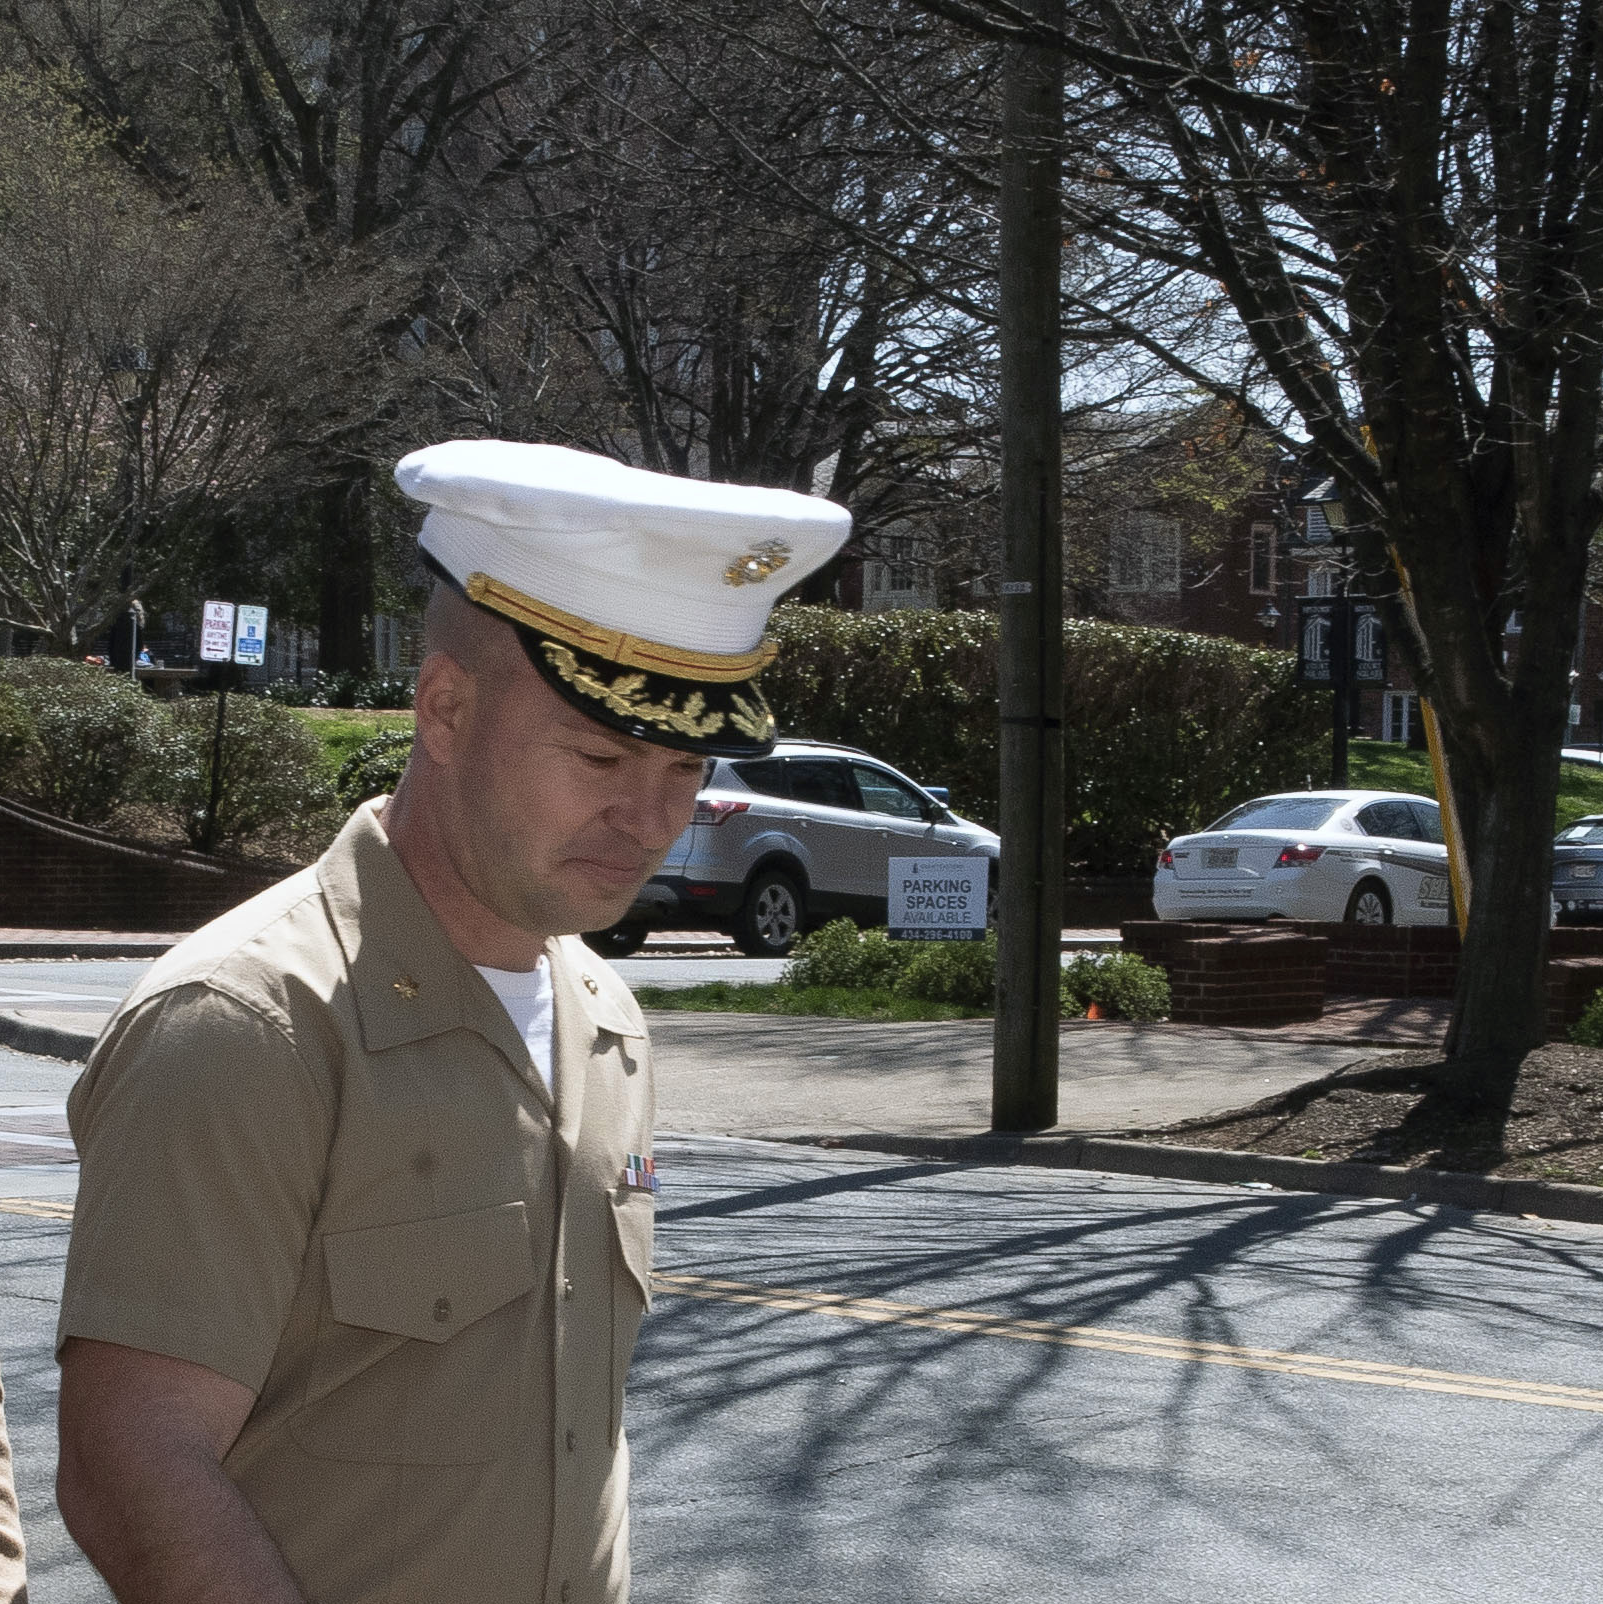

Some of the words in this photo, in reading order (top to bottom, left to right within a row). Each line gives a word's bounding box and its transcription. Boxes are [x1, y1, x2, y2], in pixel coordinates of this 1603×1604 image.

[214, 608, 225, 617] NO
[205, 619, 230, 630] PARKING
[902, 879, 972, 893] PARKING
[906, 895, 968, 909] SPACES
[902, 911, 972, 924] AVAILABLE
[901, 929, 973, 940] 434-296-4100
